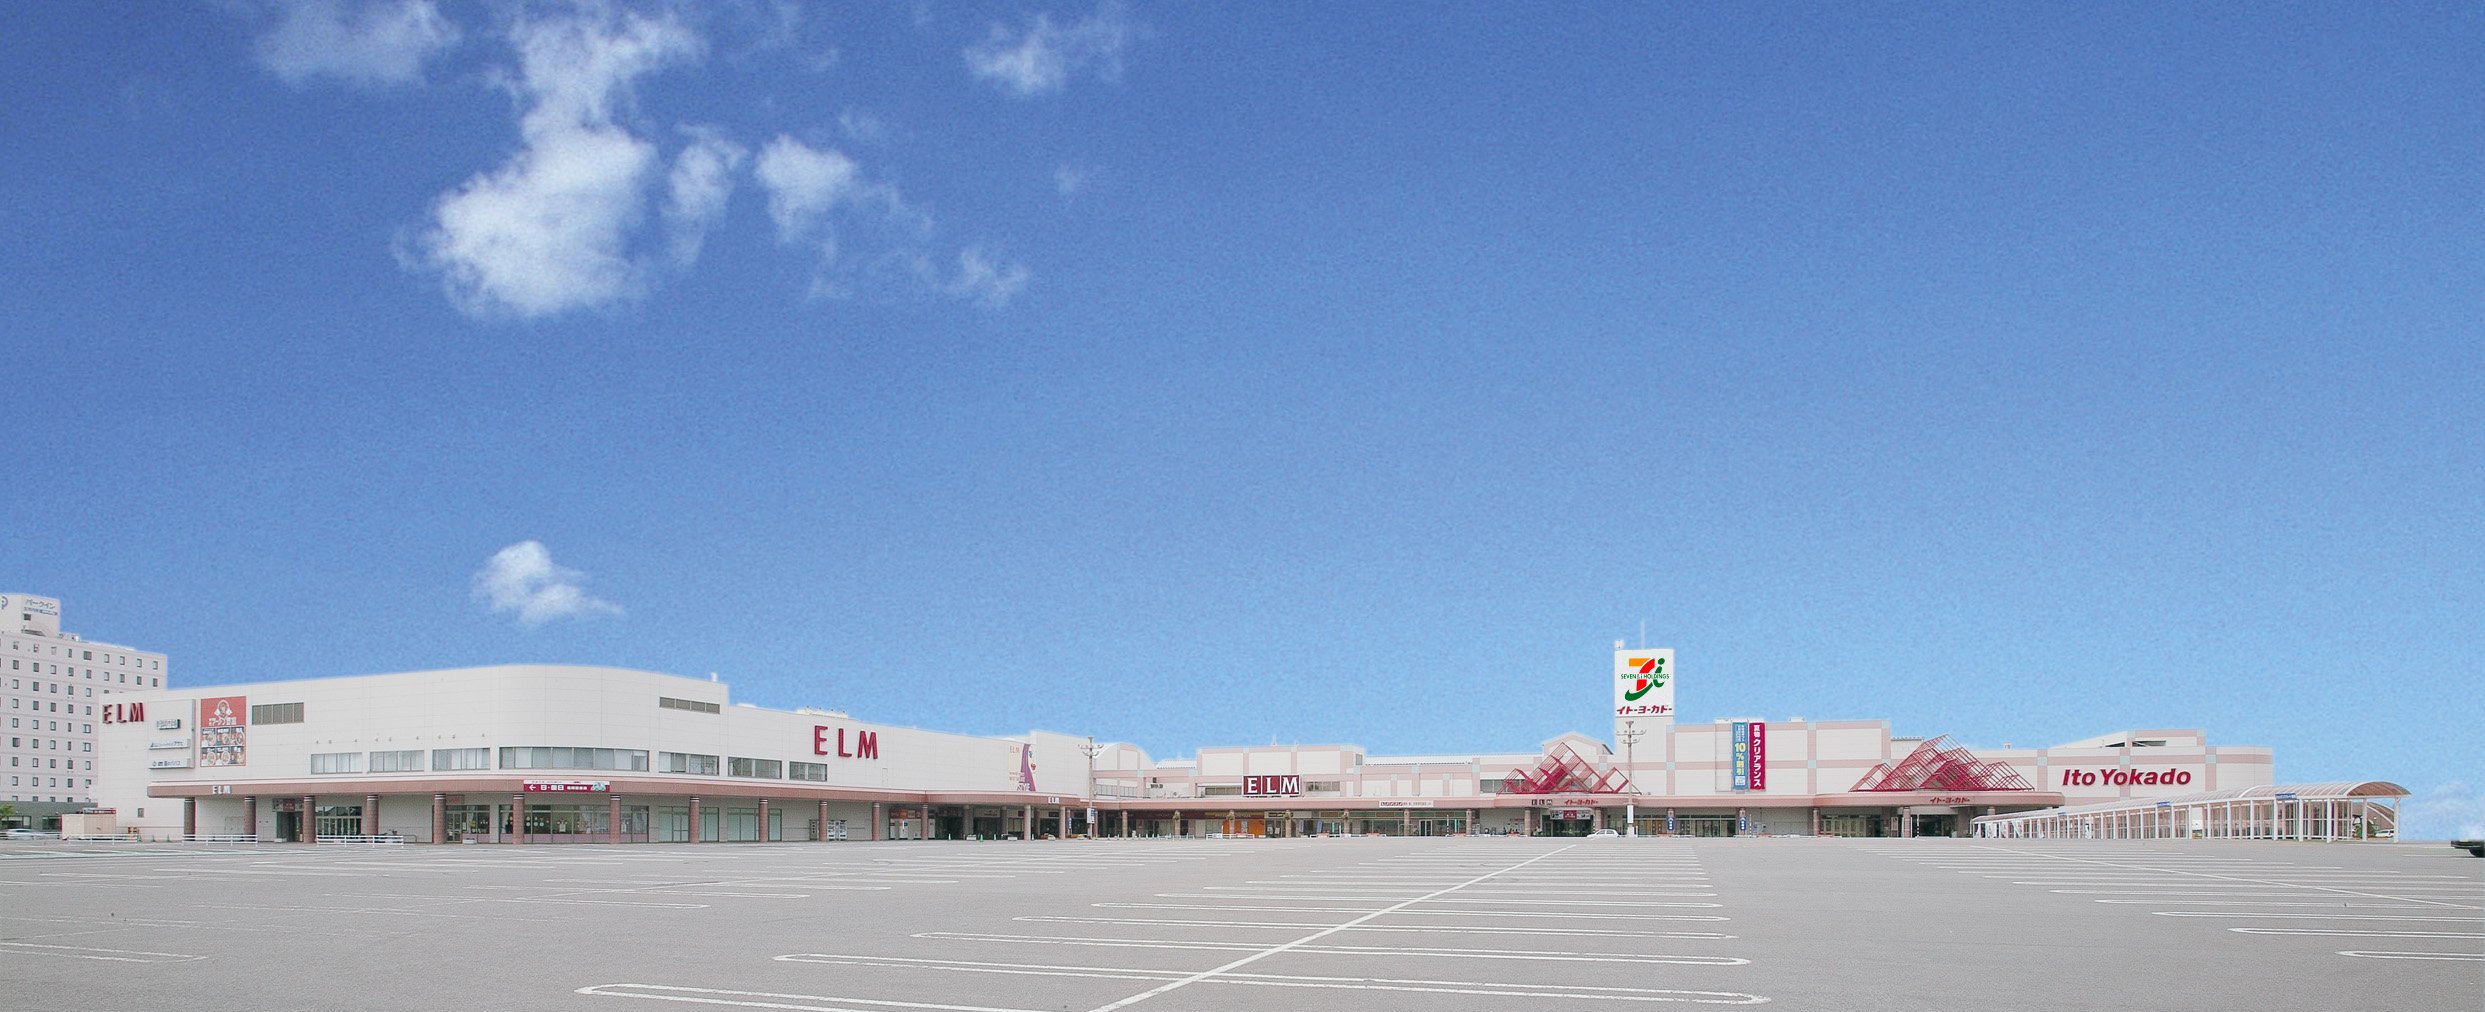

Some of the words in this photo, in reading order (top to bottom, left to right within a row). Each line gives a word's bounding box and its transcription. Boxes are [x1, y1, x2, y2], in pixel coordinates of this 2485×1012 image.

[102, 702, 145, 724] ELM
[1616, 704, 1673, 714] イトーヨーカドー
[814, 725, 879, 760] ELM
[1247, 776, 1299, 794] ELM
[2062, 769, 2097, 787] Ito
[2099, 768, 2192, 787] Yokado
[212, 785, 231, 794] ELM
